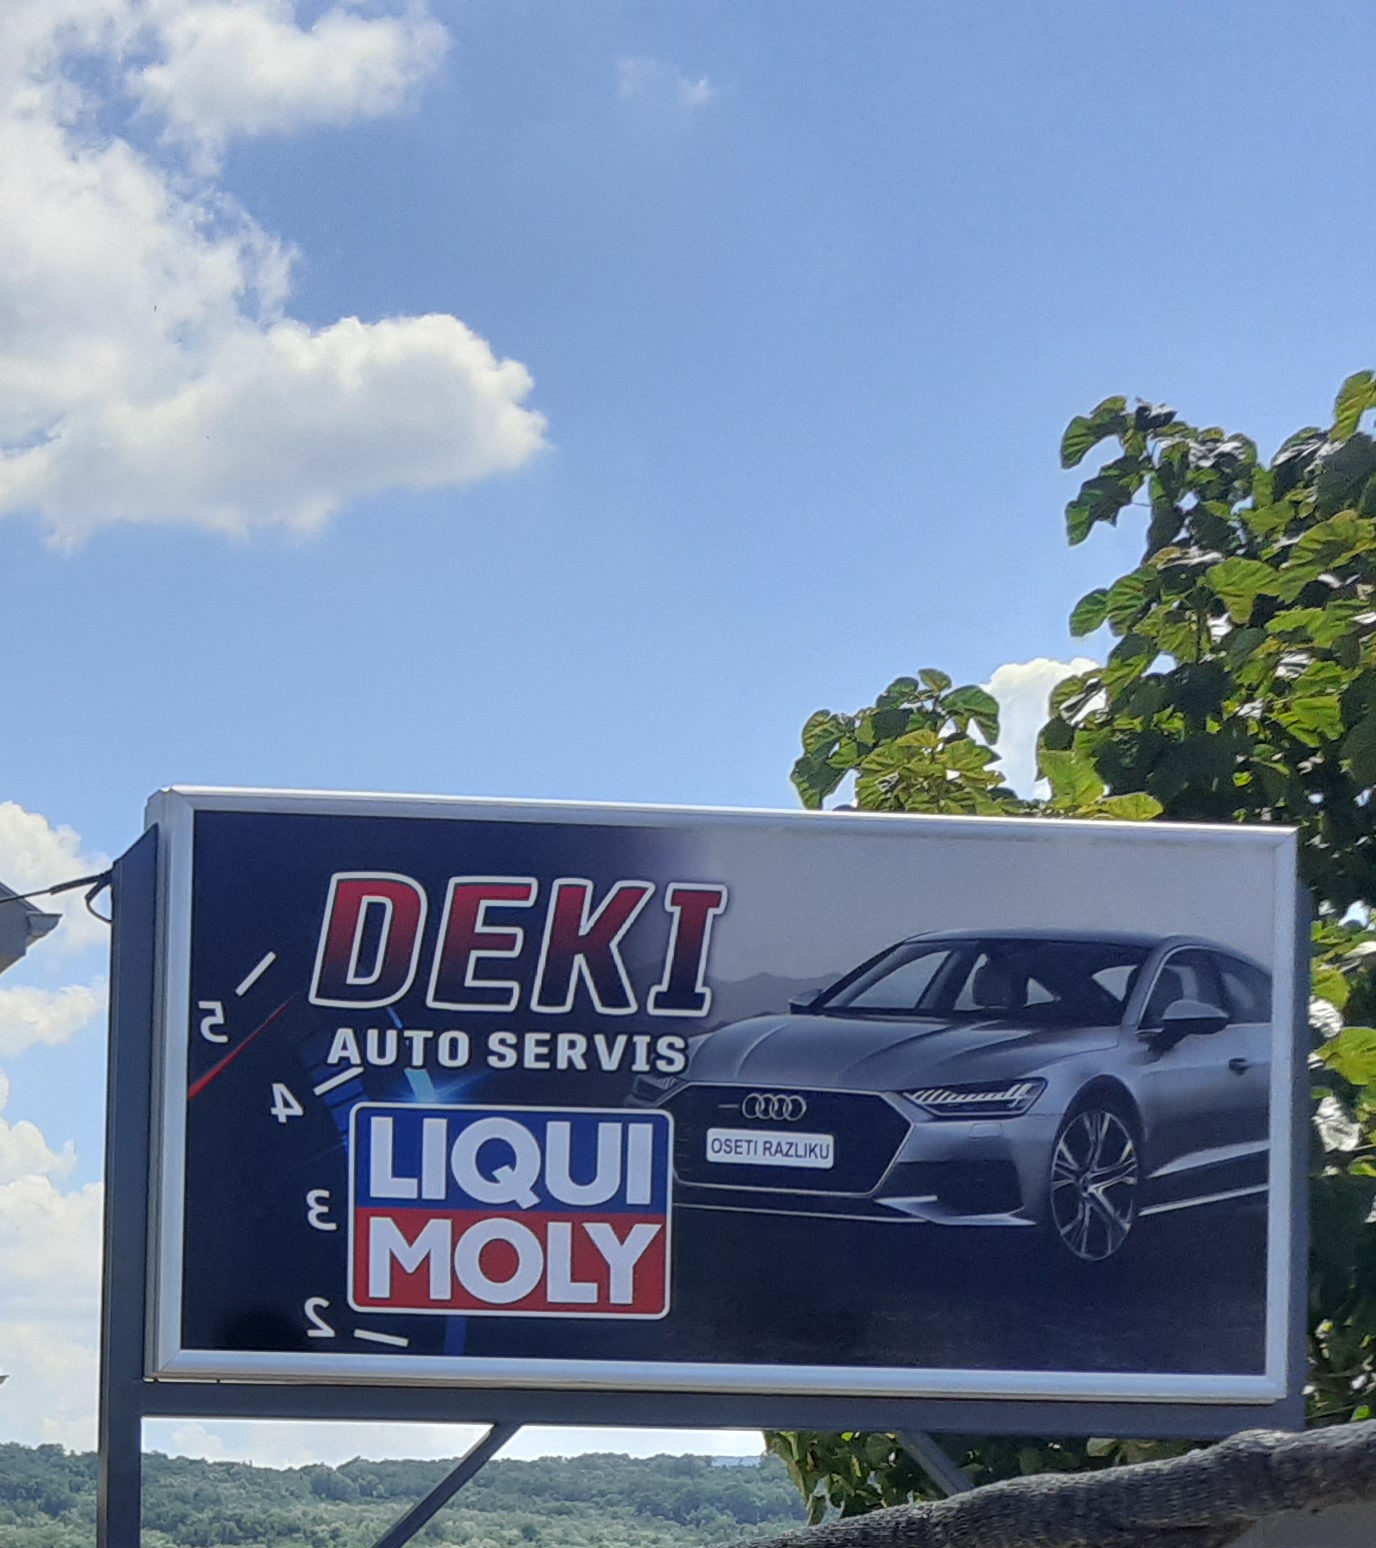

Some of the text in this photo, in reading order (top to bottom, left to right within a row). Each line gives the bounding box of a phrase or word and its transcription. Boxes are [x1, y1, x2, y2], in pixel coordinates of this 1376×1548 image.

[308, 871, 728, 1017] DEKI
[326, 1028, 689, 1073] AUTO SERVIS
[369, 1116, 654, 1210] LIQUI
[710, 1137, 831, 1161] OSETI RAZLIKU
[368, 1217, 663, 1305] MOLY
